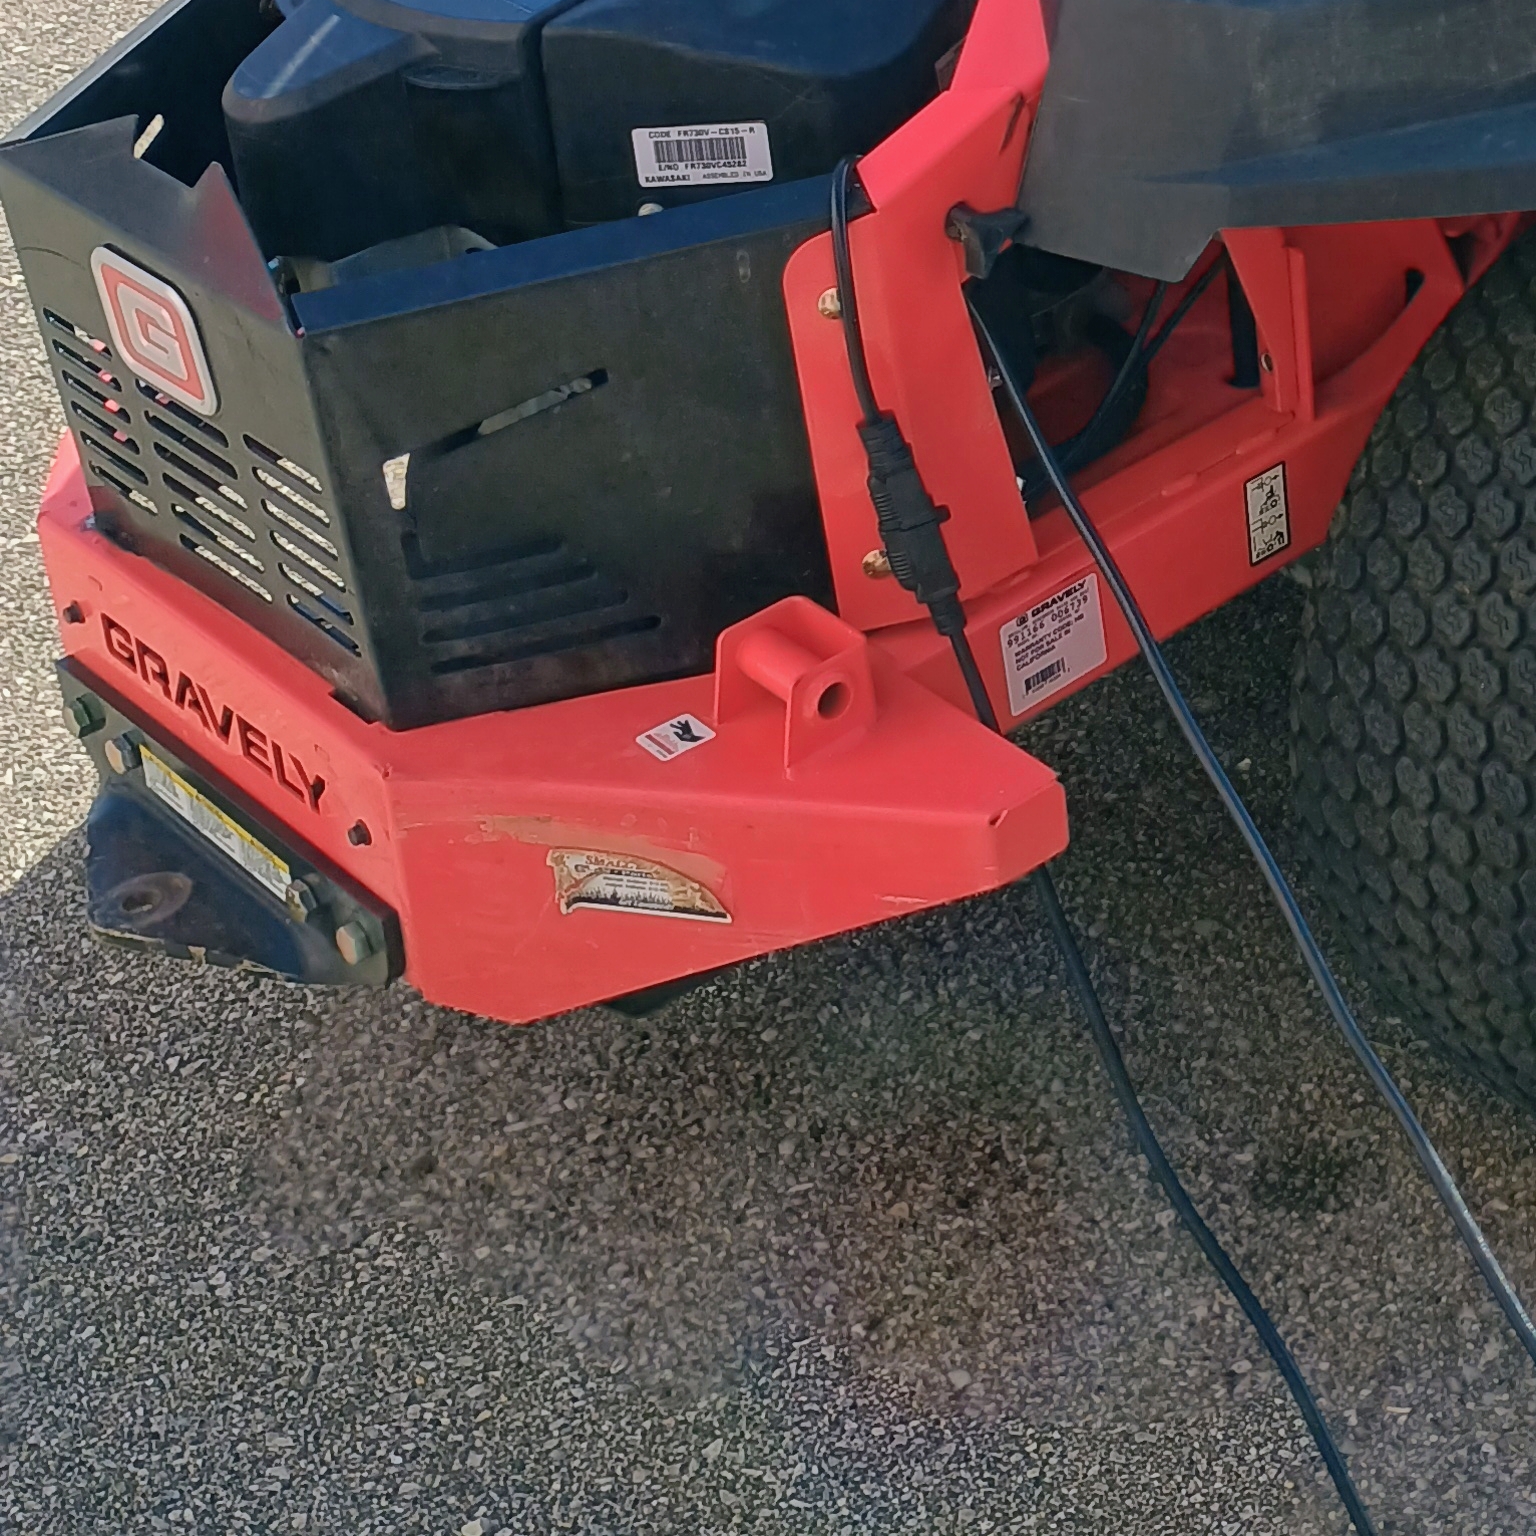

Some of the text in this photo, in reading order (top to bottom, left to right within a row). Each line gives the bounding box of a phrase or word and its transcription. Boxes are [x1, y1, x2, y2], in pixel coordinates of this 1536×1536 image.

[648, 130, 671, 138] CODE
[645, 174, 690, 183] KAWASAKI
[1031, 579, 1086, 617] GRAVELY
[1014, 632, 1052, 657] WARRANTY
[1015, 652, 1029, 664] NOT
[1031, 644, 1044, 657] FOR
[1046, 634, 1063, 647] SALE
[1016, 645, 1056, 671] CALIFORNIA
[100, 612, 326, 815] GRAVELY
